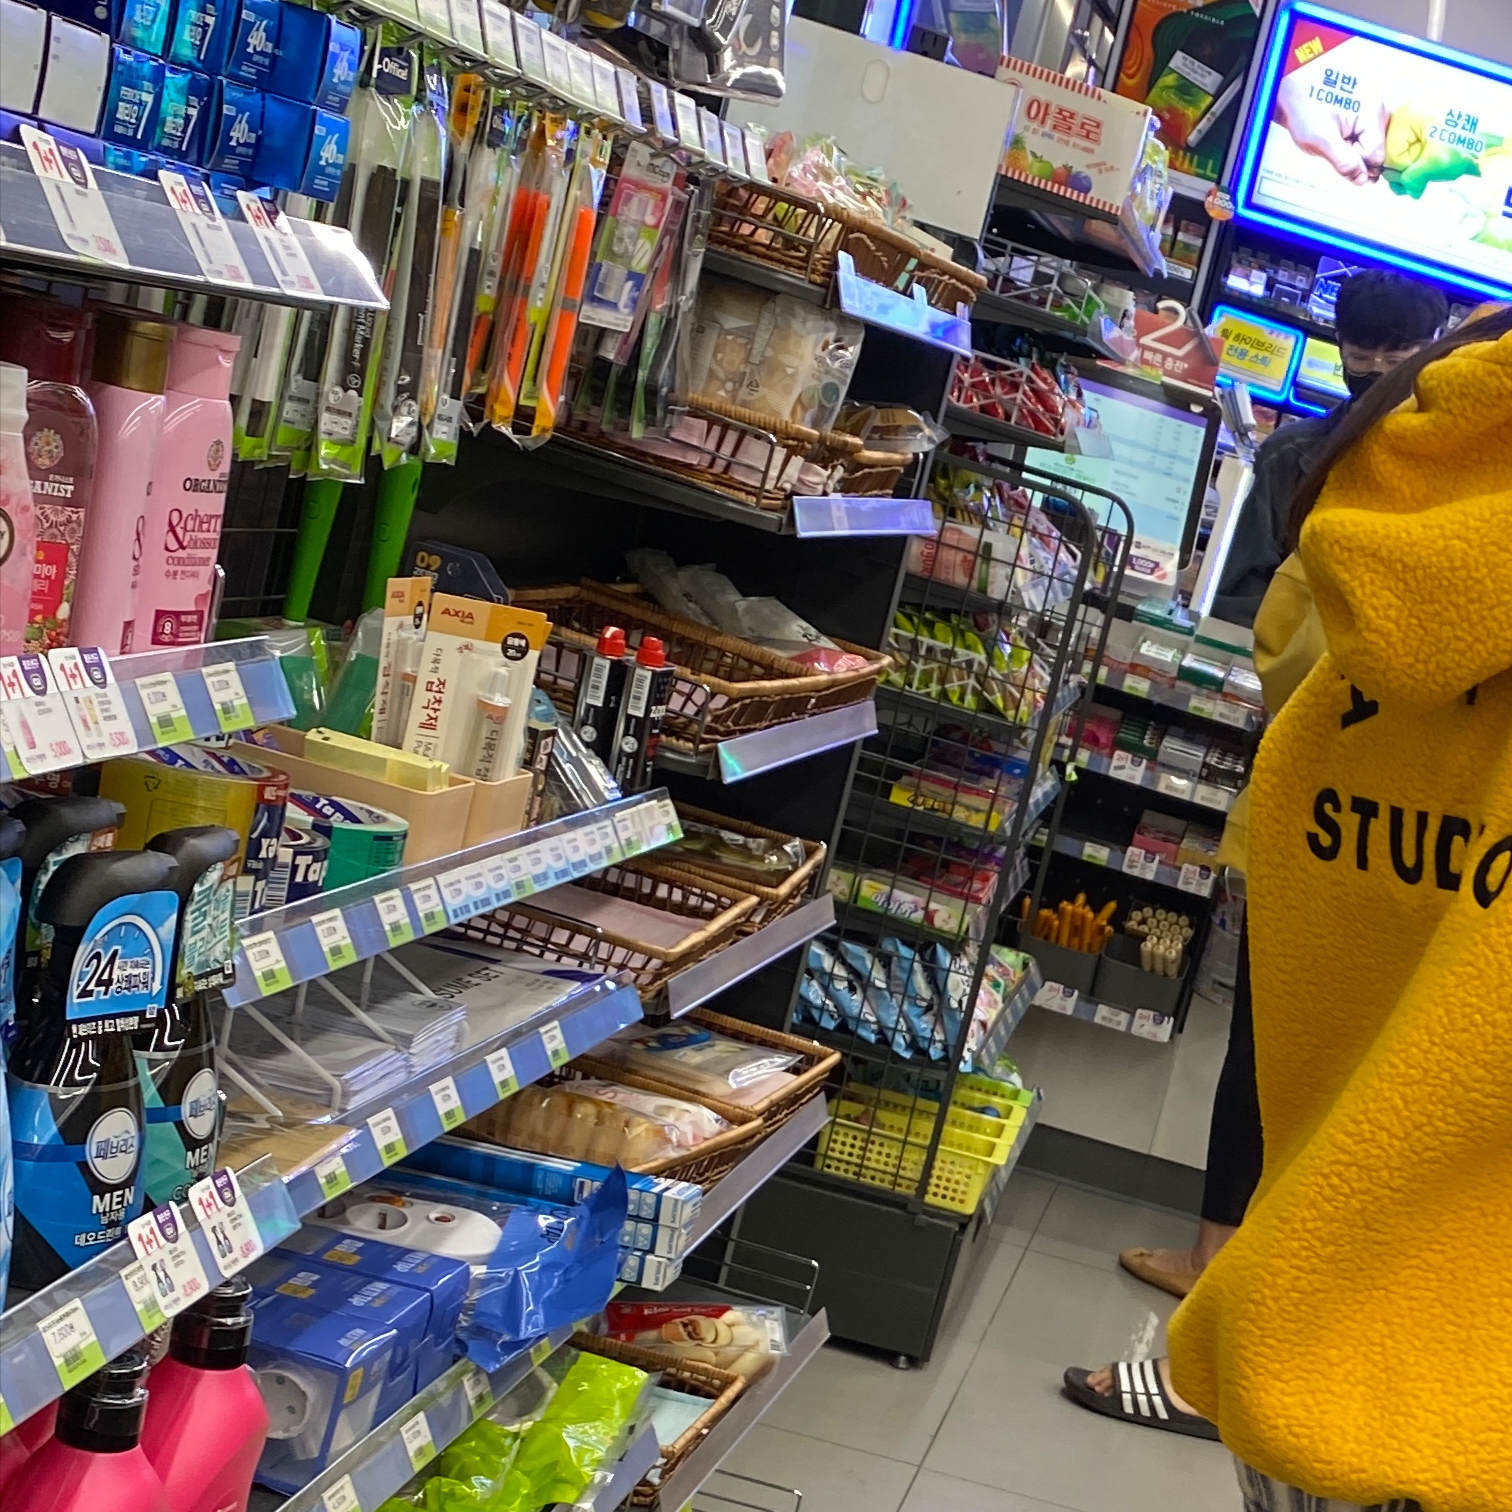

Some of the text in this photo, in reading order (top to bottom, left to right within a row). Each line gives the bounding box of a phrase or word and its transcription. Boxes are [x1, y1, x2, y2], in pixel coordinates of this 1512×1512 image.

[1294, 37, 1324, 64] NEW
[1322, 68, 1359, 94] 일반
[1317, 88, 1362, 113] COMBO
[1024, 96, 1104, 146] 아폴로
[1445, 107, 1481, 134] 상쾌
[1438, 129, 1485, 154] COMBO
[32, 140, 65, 179] 1+1
[170, 184, 200, 215] 1+1
[1315, 277, 1342, 301] NE
[30, 481, 75, 498] GANIST
[164, 508, 222, 553] & cherr
[187, 534, 220, 551] blosso
[440, 606, 475, 622] AXIA
[59, 661, 87, 691] 1+1
[417, 677, 447, 732] 접착제
[75, 945, 122, 1003] 24
[94, 1135, 136, 1162] 페브리즈
[92, 1186, 135, 1214] MEN
[198, 1190, 222, 1220] 1+1
[100, 1208, 127, 1224] 남자용
[137, 1225, 162, 1256] 1+1
